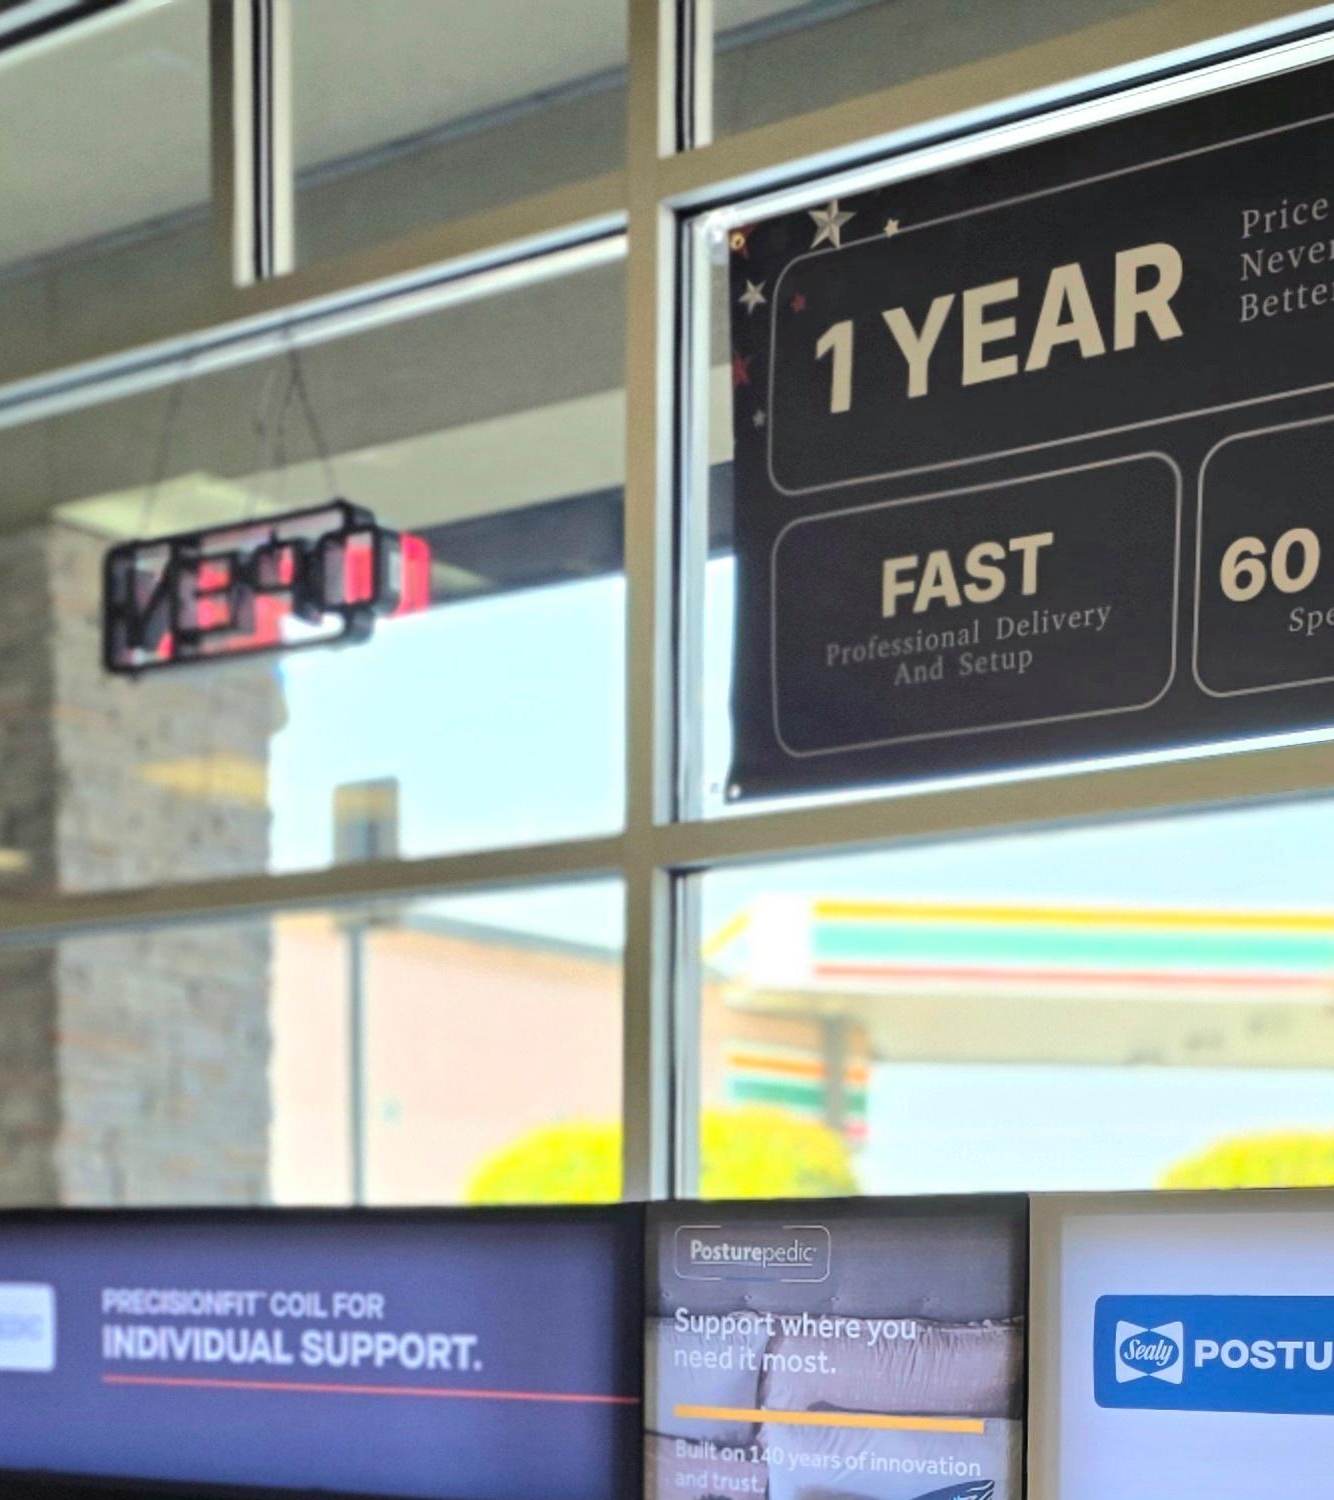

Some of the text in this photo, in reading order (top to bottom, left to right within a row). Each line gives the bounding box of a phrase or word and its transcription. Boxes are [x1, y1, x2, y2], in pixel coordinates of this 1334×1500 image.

[1241, 199, 1329, 240] Price
[816, 242, 1184, 414] 1 YEAR
[882, 532, 1054, 618] FAST
[1220, 527, 1321, 602] 60
[826, 605, 1112, 667] Professional Delivery
[894, 648, 1034, 686] And Setup
[690, 1239, 817, 1268] Posturepedic
[269, 1292, 328, 1318] COIL
[332, 1293, 385, 1319] FOR
[674, 1307, 917, 1347] Support where you
[102, 1324, 483, 1372] INDIVIDUAL SUPPORT.
[674, 1346, 836, 1374] need it most.
[1123, 1339, 1173, 1367] Sealy
[675, 1439, 982, 1477] Built on 140 years of innovation
[675, 1470, 767, 1494] and trust.
